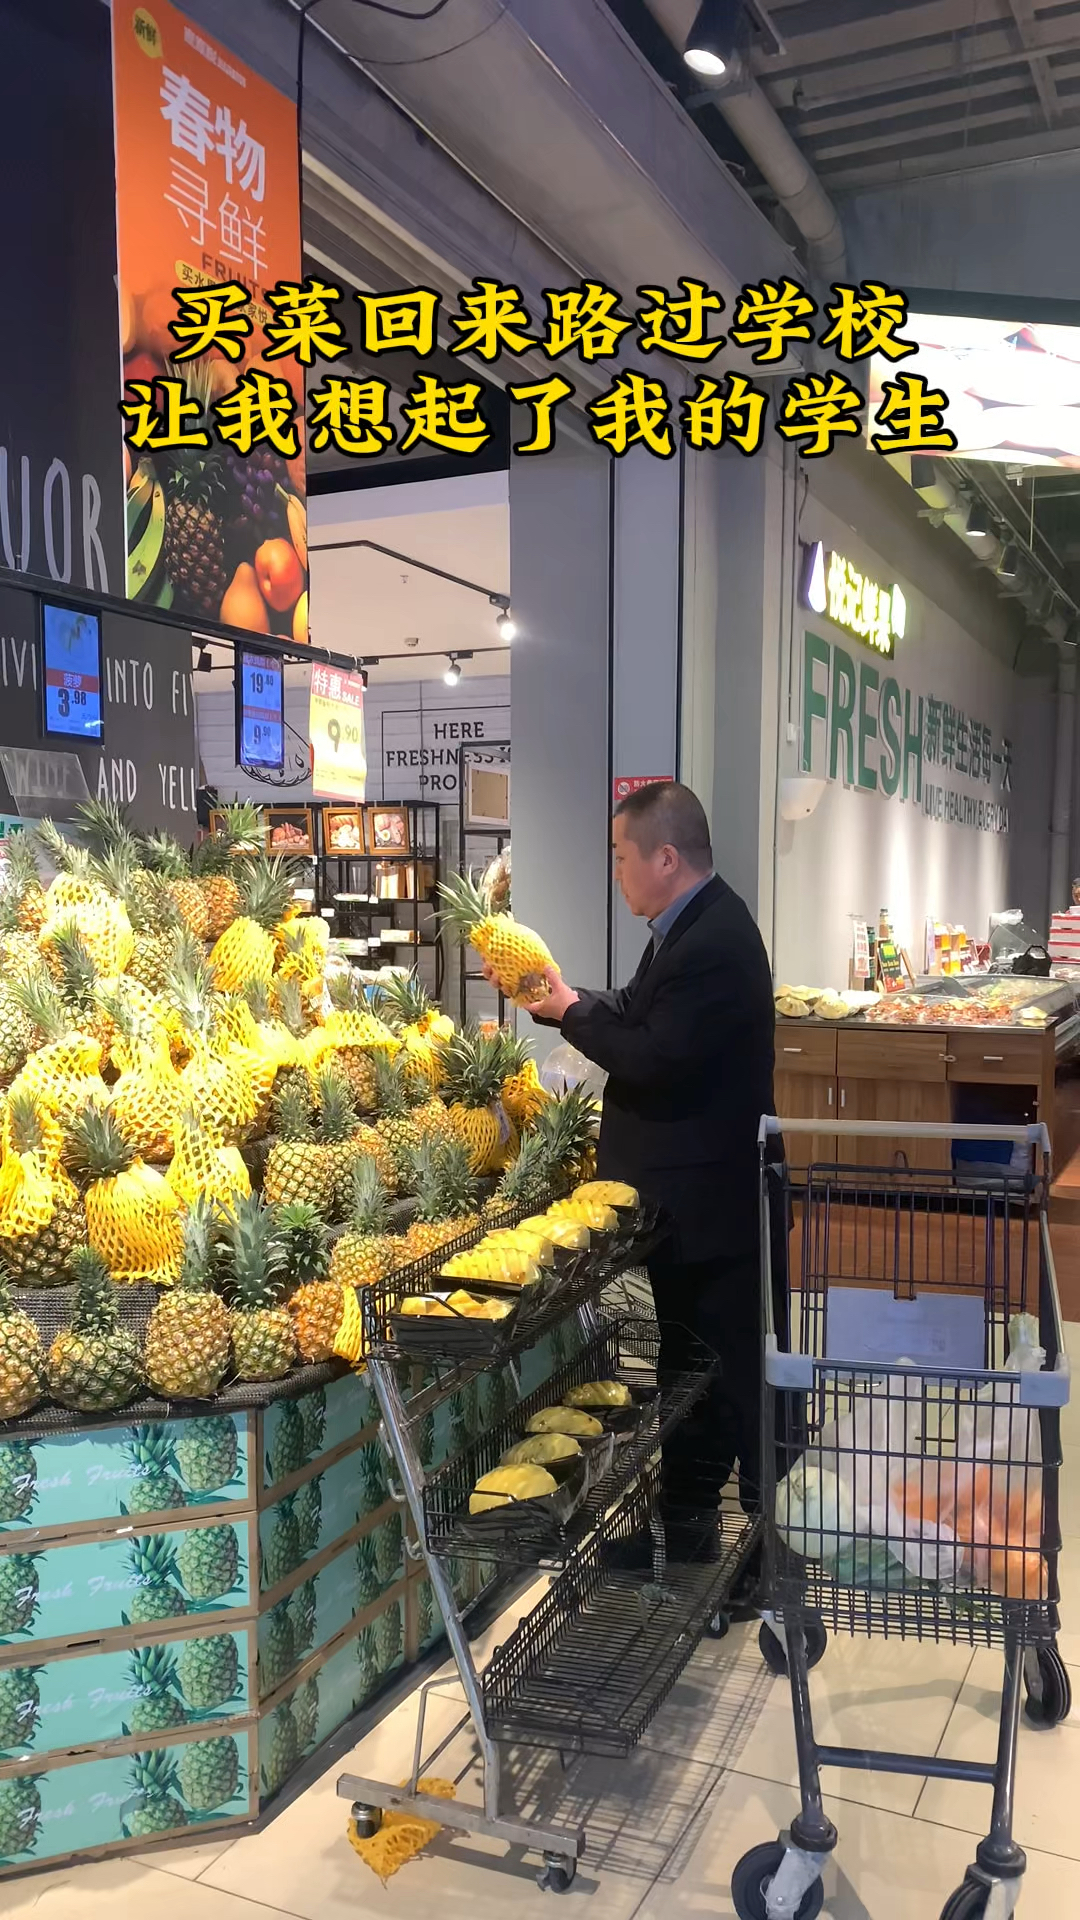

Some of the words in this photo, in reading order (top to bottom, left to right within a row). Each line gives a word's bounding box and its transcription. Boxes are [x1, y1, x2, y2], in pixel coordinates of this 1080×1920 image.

[160, 65, 265, 202] 春物
[164, 157, 268, 280] 寻鲜
[63, 673, 83, 688] 菠萝
[106, 657, 153, 711] INTO
[315, 669, 341, 700] 特惠
[342, 691, 360, 705] SALE
[58, 688, 87, 717] 3.98
[802, 630, 924, 803] FRESH
[327, 718, 359, 753] 9.90
[434, 721, 484, 739] HERE
[925, 693, 1013, 793] 新鲜生活每一天
[97, 757, 137, 803] AND
[158, 763, 197, 812] YELL
[925, 783, 943, 820] LIVE
[944, 789, 977, 825] HEALTHY
[13, 1470, 72, 1496] Fresh
[86, 1463, 152, 1487] Fruits
[15, 1581, 74, 1608] Fresh
[87, 1573, 153, 1597] Fruits
[16, 1694, 74, 1722] Fresh
[87, 1685, 153, 1710] Fruits
